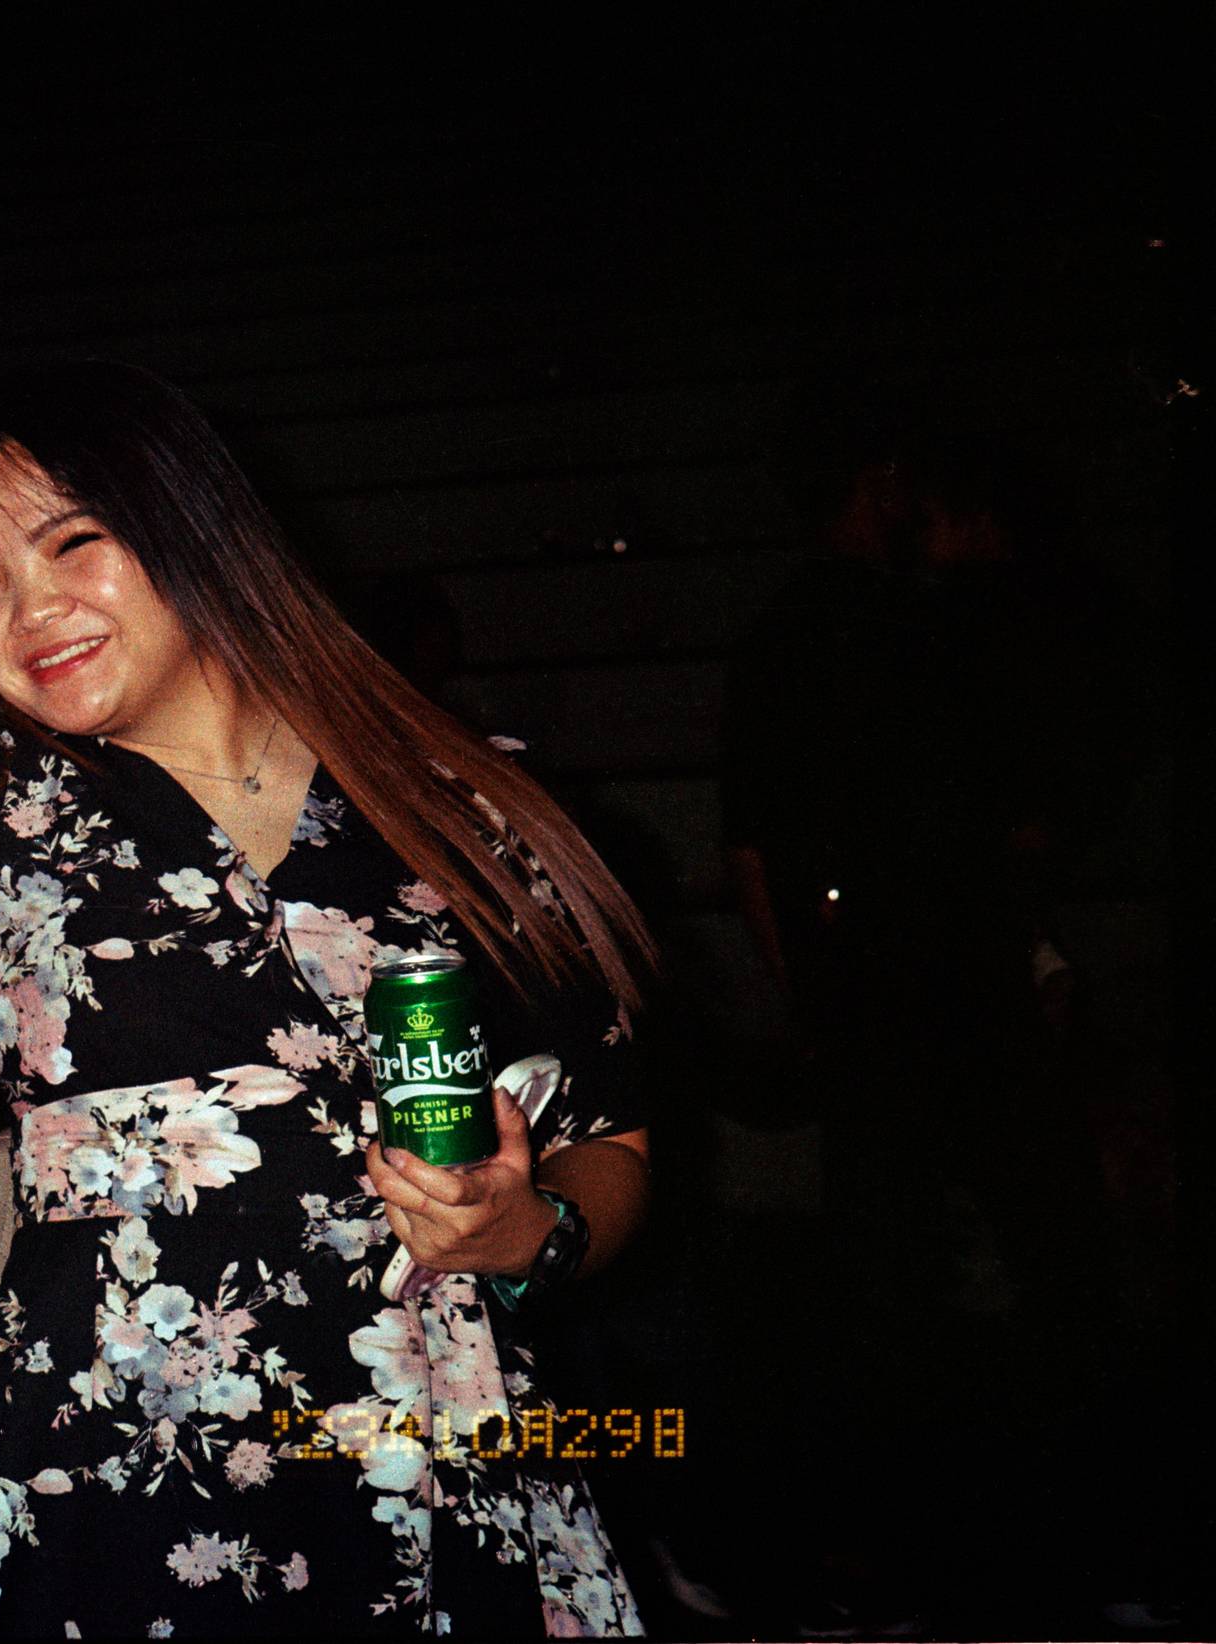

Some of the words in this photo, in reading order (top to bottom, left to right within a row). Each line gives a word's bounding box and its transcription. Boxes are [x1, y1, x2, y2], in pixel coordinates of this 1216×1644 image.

[368, 1032, 488, 1082] arlsber
[413, 1099, 448, 1109] DANISH
[392, 1105, 473, 1125] PILSNER
